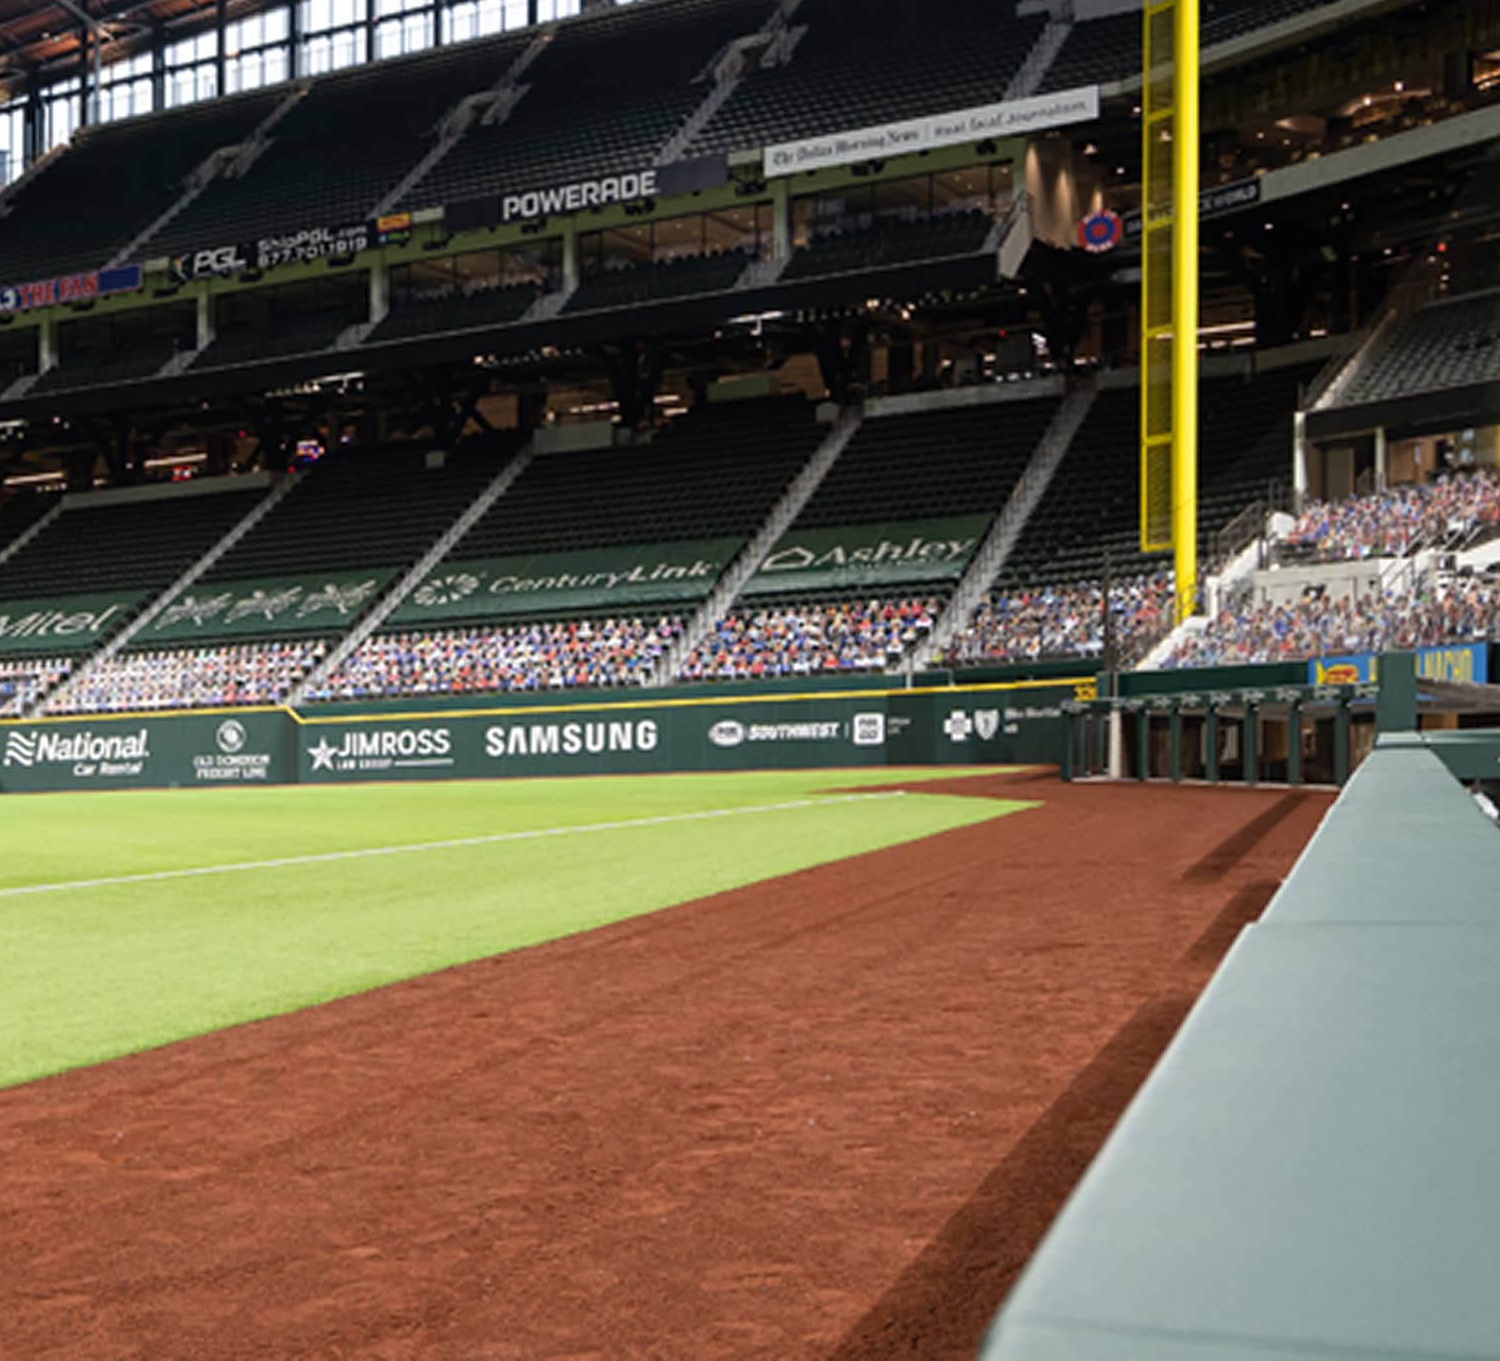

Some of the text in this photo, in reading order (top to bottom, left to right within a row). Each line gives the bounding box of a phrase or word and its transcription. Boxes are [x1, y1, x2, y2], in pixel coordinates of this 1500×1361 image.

[503, 170, 656, 221] POWERADE
[194, 246, 247, 274] PGL
[21, 282, 56, 306] THE
[59, 274, 98, 300] FAN
[814, 539, 976, 566] Ashley
[490, 560, 710, 593] CenturyLink
[486, 720, 657, 757] SAMSUNG
[73, 761, 96, 776] Car
